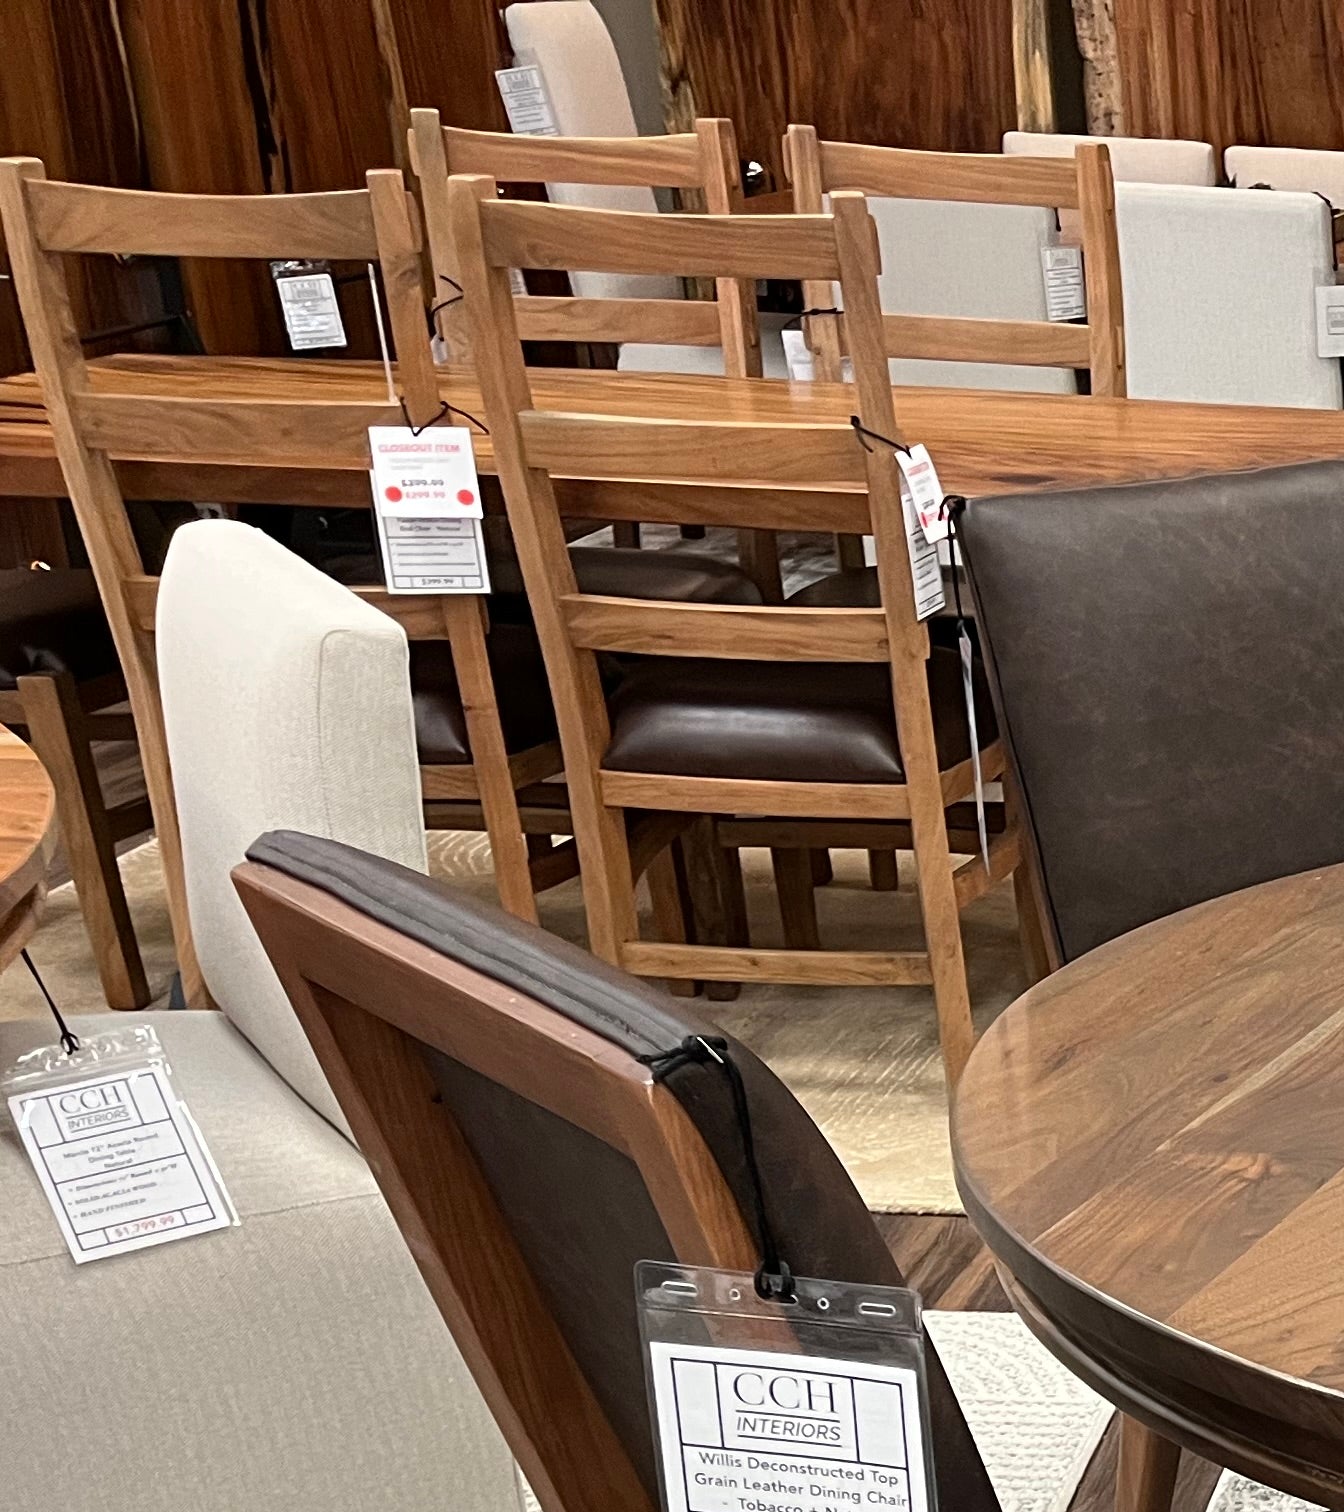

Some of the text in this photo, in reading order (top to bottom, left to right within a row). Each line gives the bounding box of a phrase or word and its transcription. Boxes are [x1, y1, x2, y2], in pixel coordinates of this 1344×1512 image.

[59, 1085, 122, 1114] CCH
[67, 1108, 129, 1130] INTERIORS
[733, 1372, 839, 1414] CCH
[736, 1416, 841, 1441] INTERIORS
[698, 1451, 899, 1487] Willis Deconstructed Top
[694, 1472, 908, 1507] Grain Leather Dining Chair
